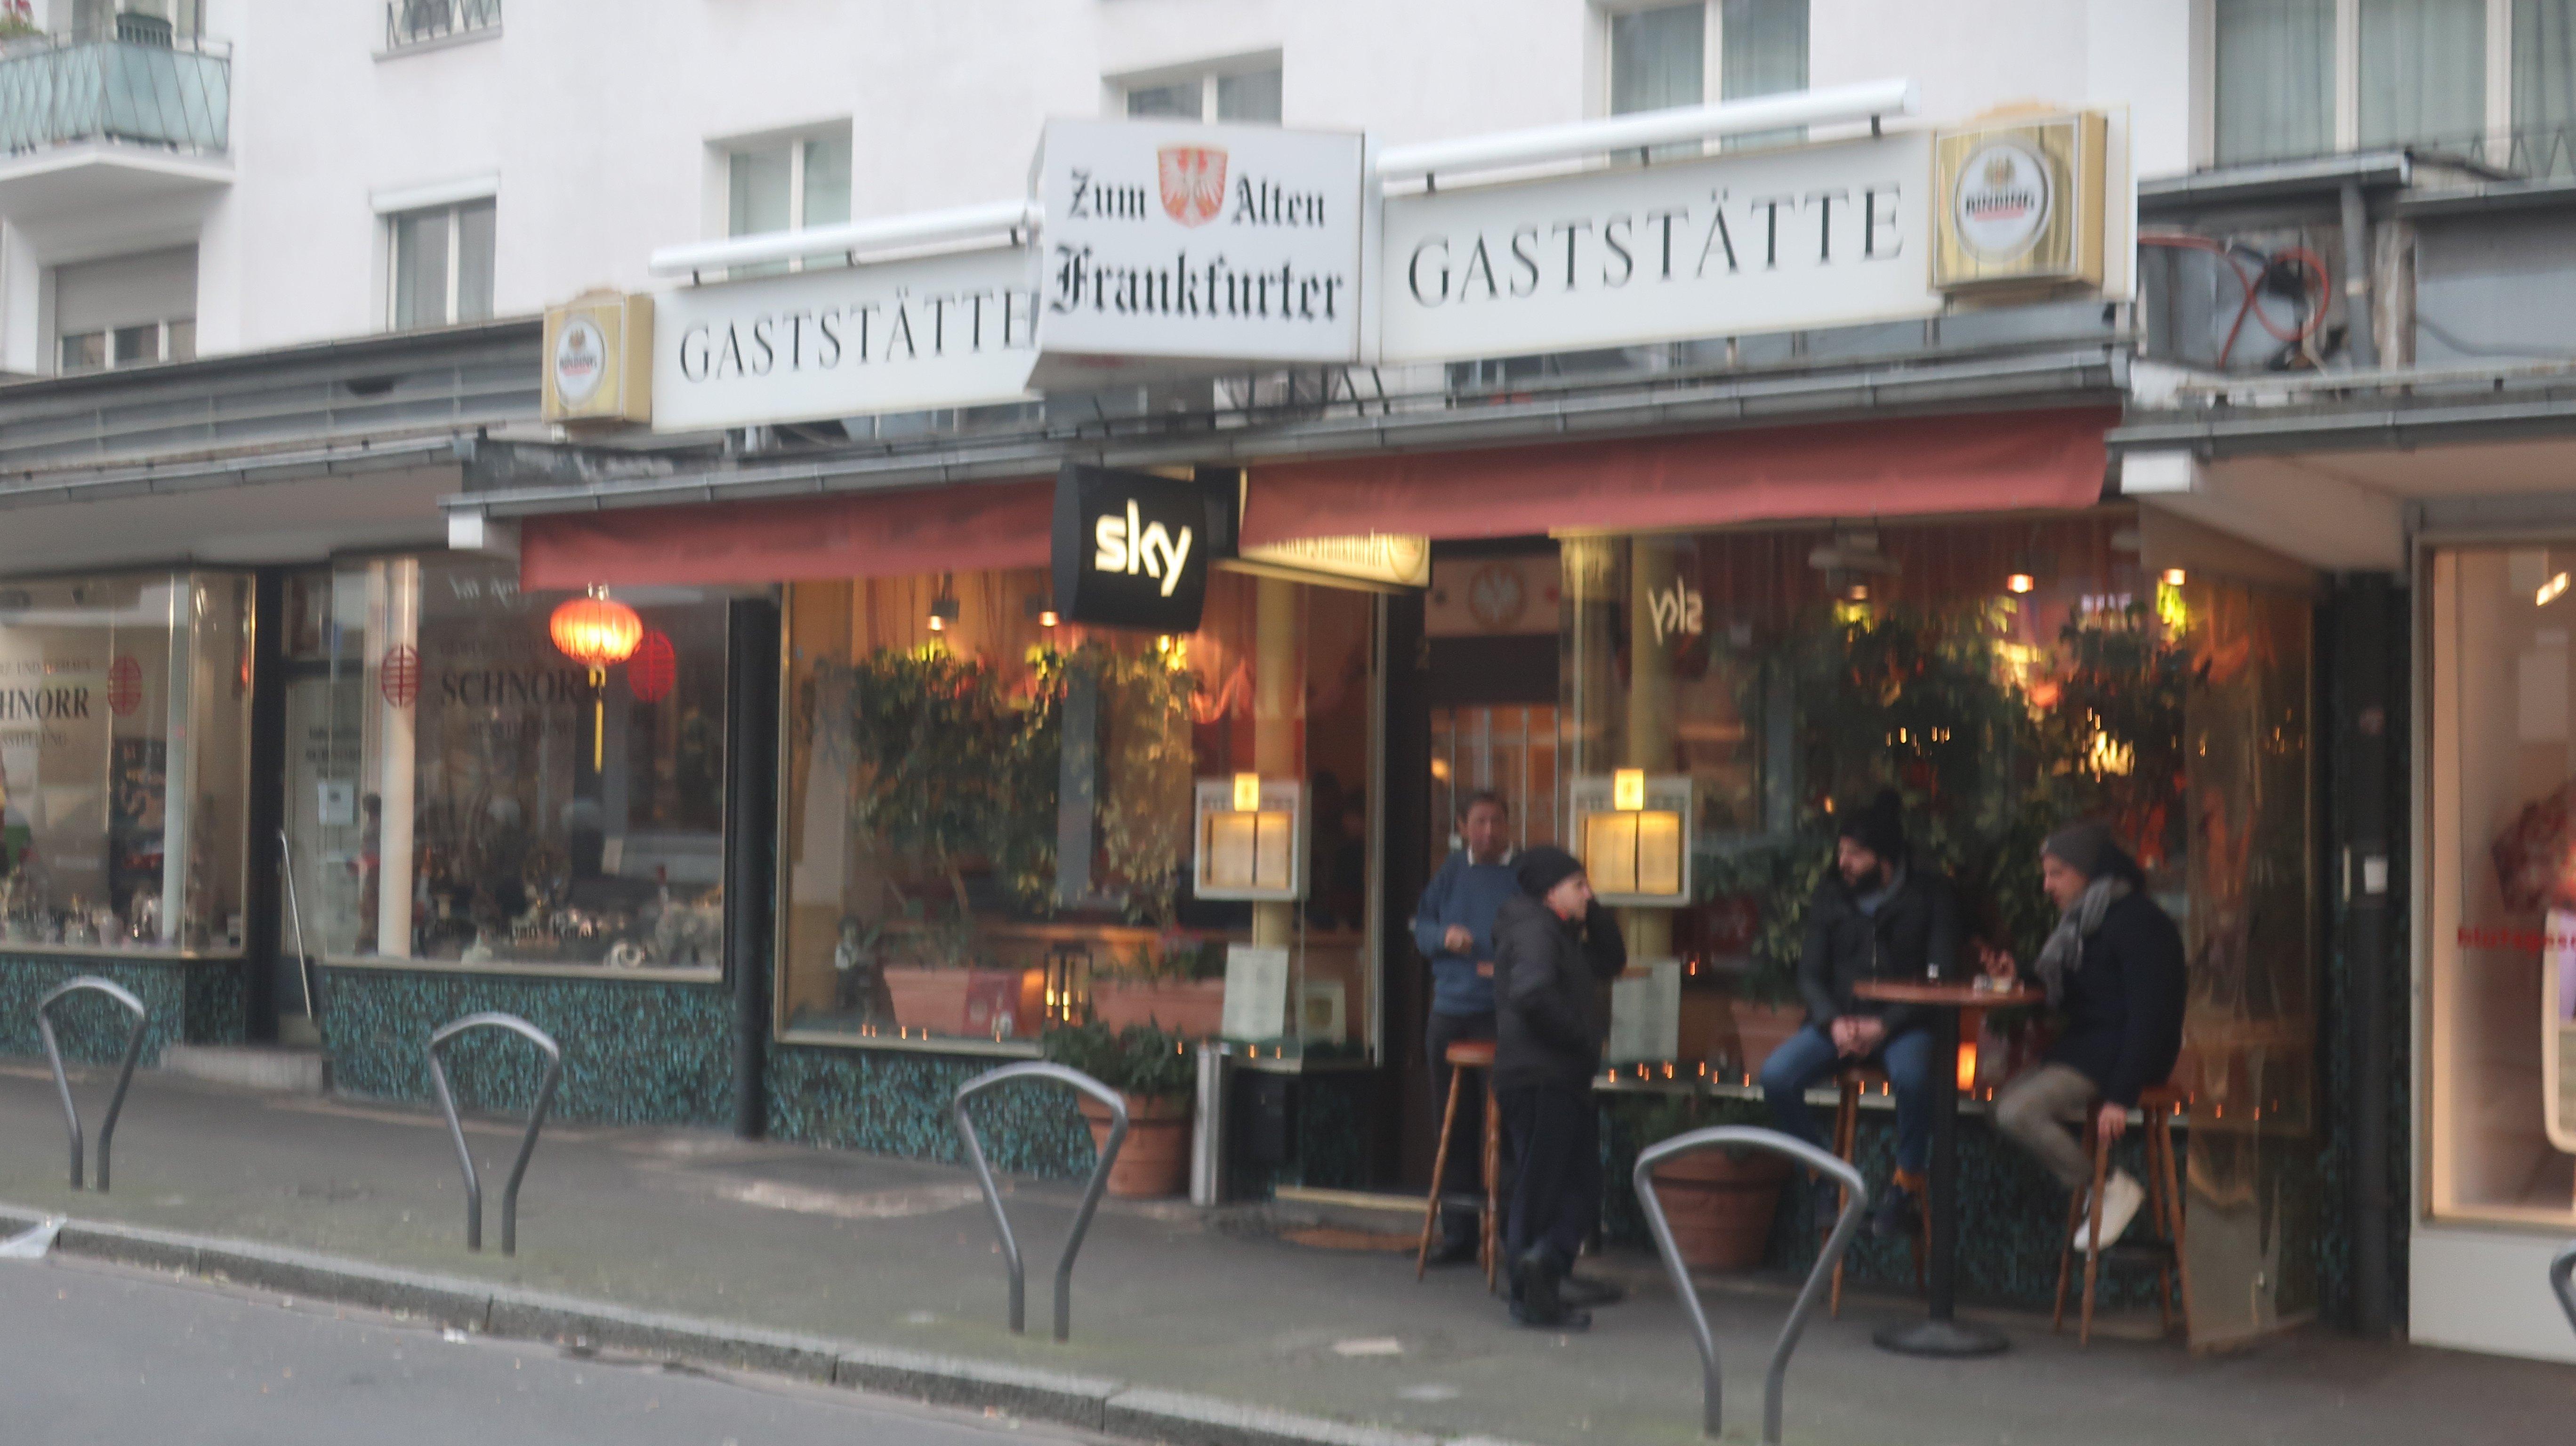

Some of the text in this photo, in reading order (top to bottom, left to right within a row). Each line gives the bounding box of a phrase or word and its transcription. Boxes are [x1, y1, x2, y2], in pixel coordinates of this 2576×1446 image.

[1068, 165, 1326, 229] Zum Alten
[1049, 240, 1344, 323] Frankfurter
[1408, 186, 1905, 309] GASTSTÄTTE
[679, 287, 1032, 382] GASTSTÄTTE
[1095, 497, 1193, 598] sky
